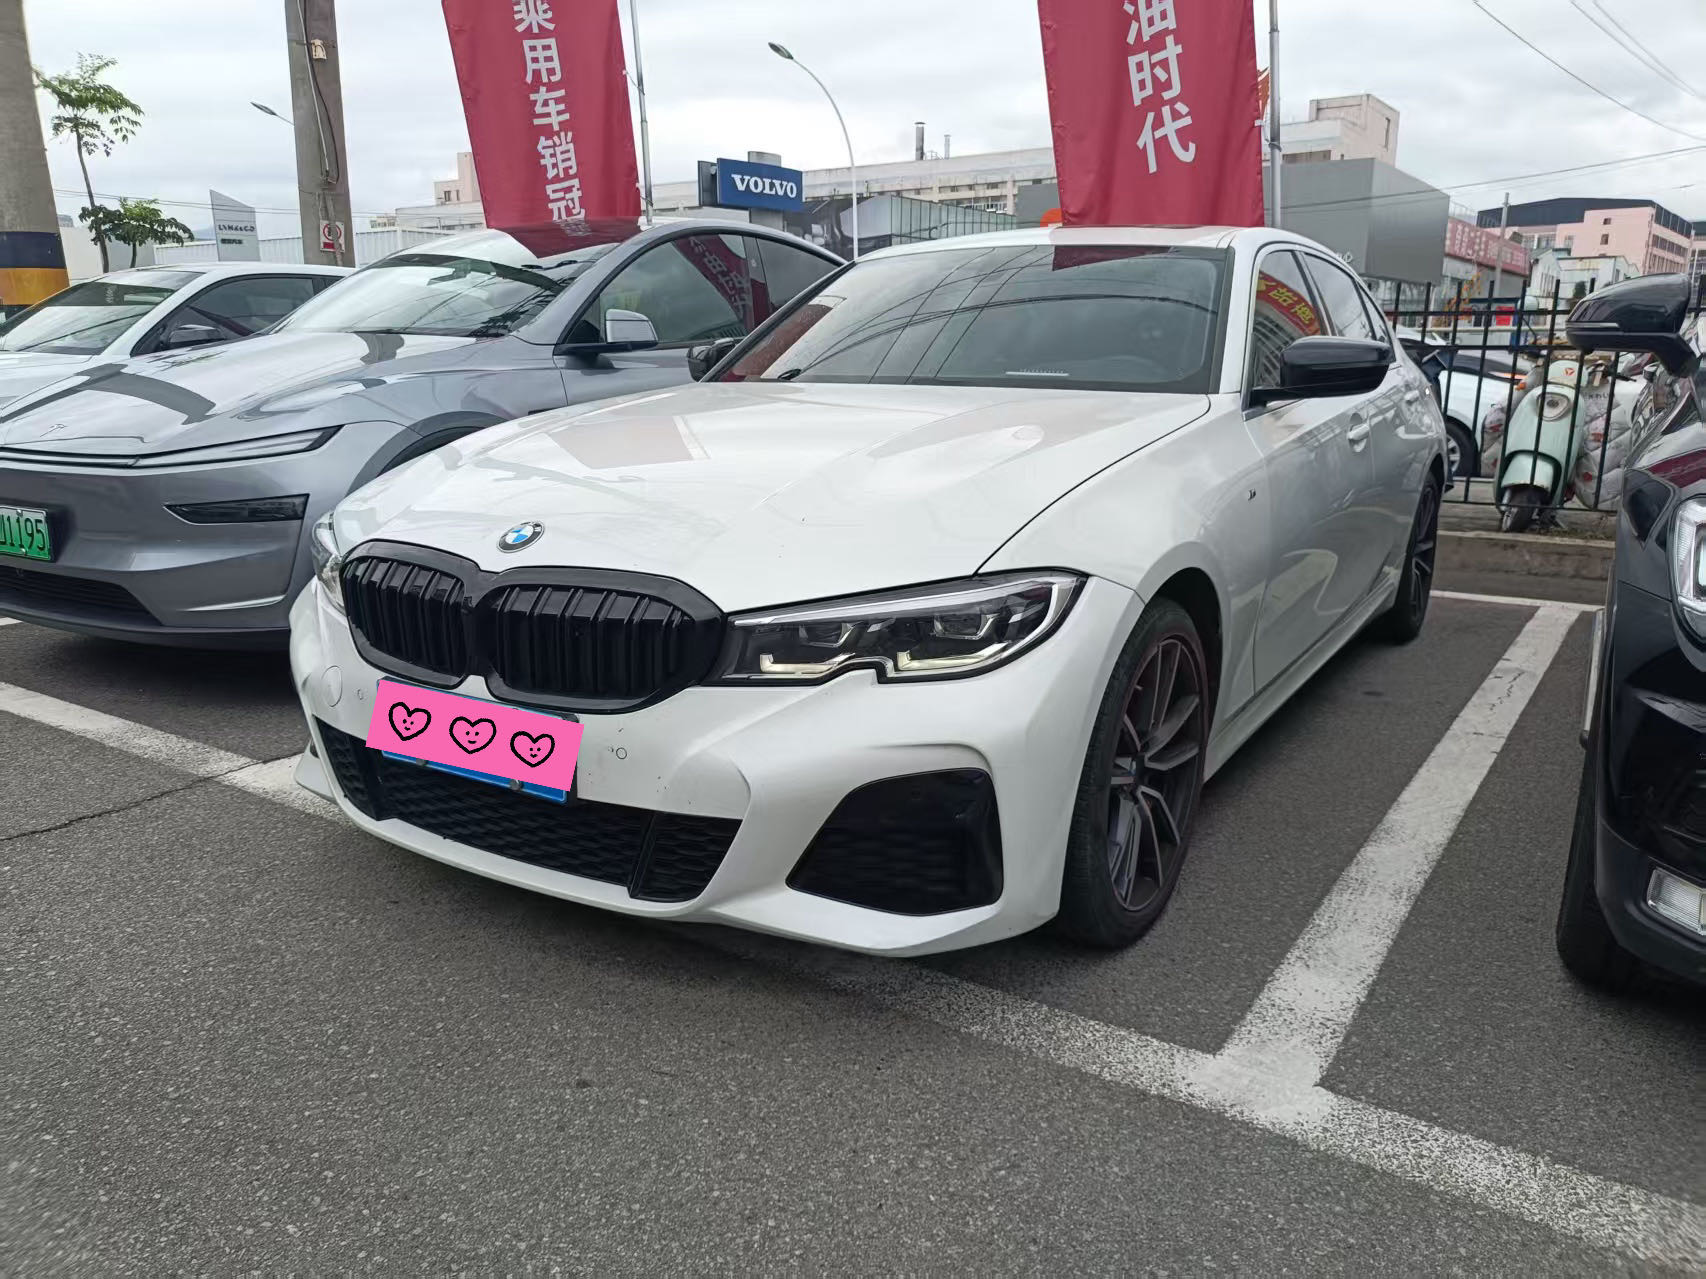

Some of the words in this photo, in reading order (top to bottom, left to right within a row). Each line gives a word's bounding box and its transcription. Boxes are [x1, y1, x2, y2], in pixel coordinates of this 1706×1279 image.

[513, 0, 585, 221] 乘用车销冠
[1123, 0, 1196, 174] 油时代
[731, 174, 797, 198] VOLVO
